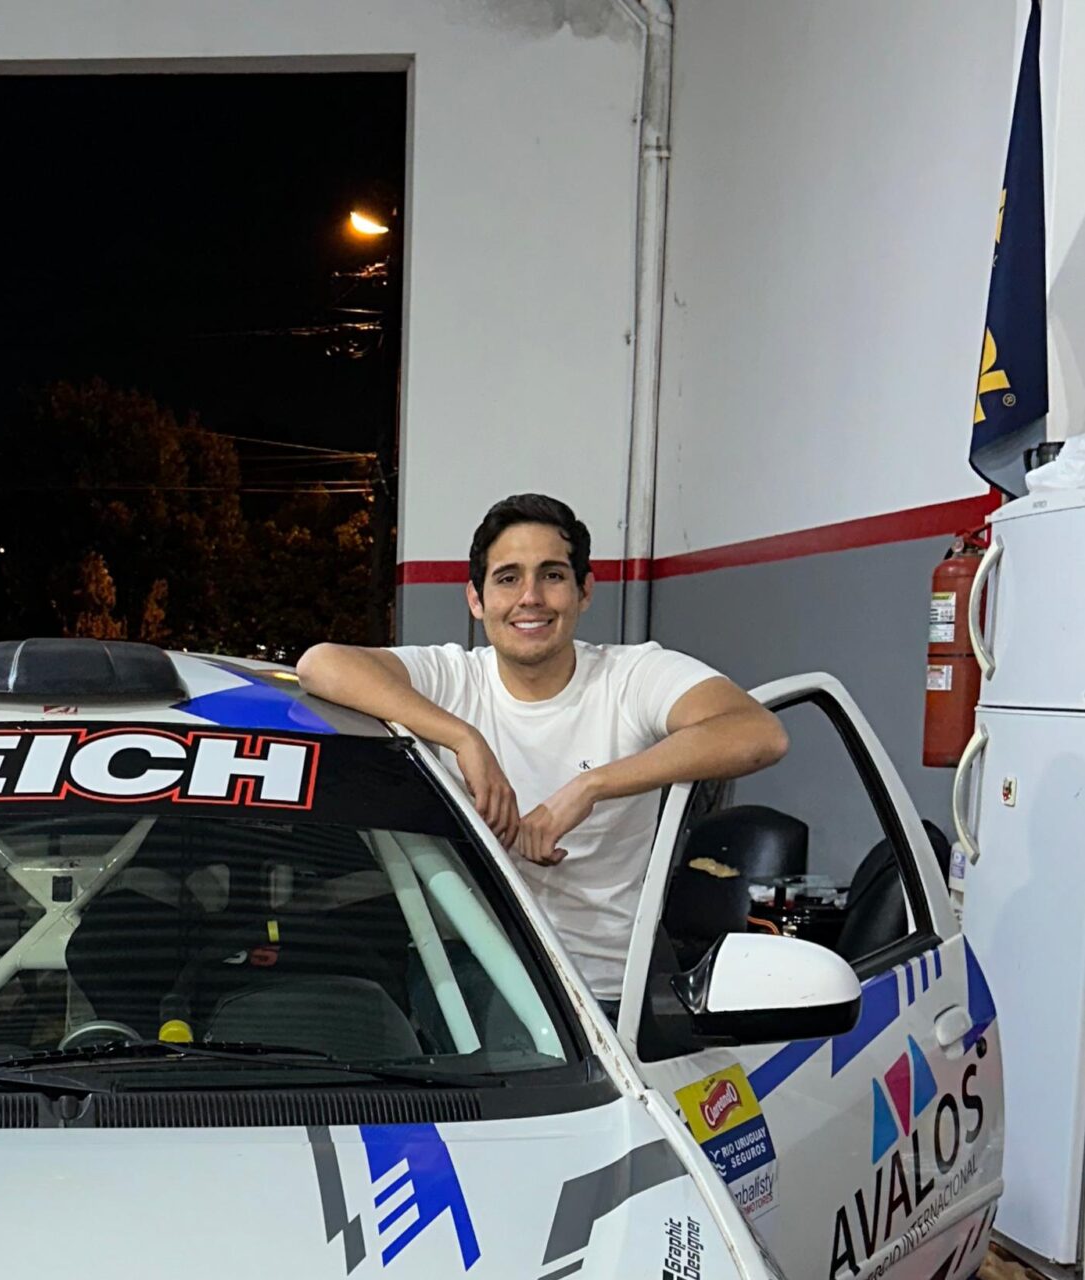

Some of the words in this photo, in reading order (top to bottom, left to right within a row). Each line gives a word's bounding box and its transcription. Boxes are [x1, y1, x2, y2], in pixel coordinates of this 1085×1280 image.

[721, 1143, 735, 1158] RIO
[735, 1126, 767, 1151] URUGUAY
[730, 1142, 766, 1169] SEGUROS
[900, 1153, 979, 1256] INTERNACIONAL
[664, 1217, 686, 1274] Graphic
